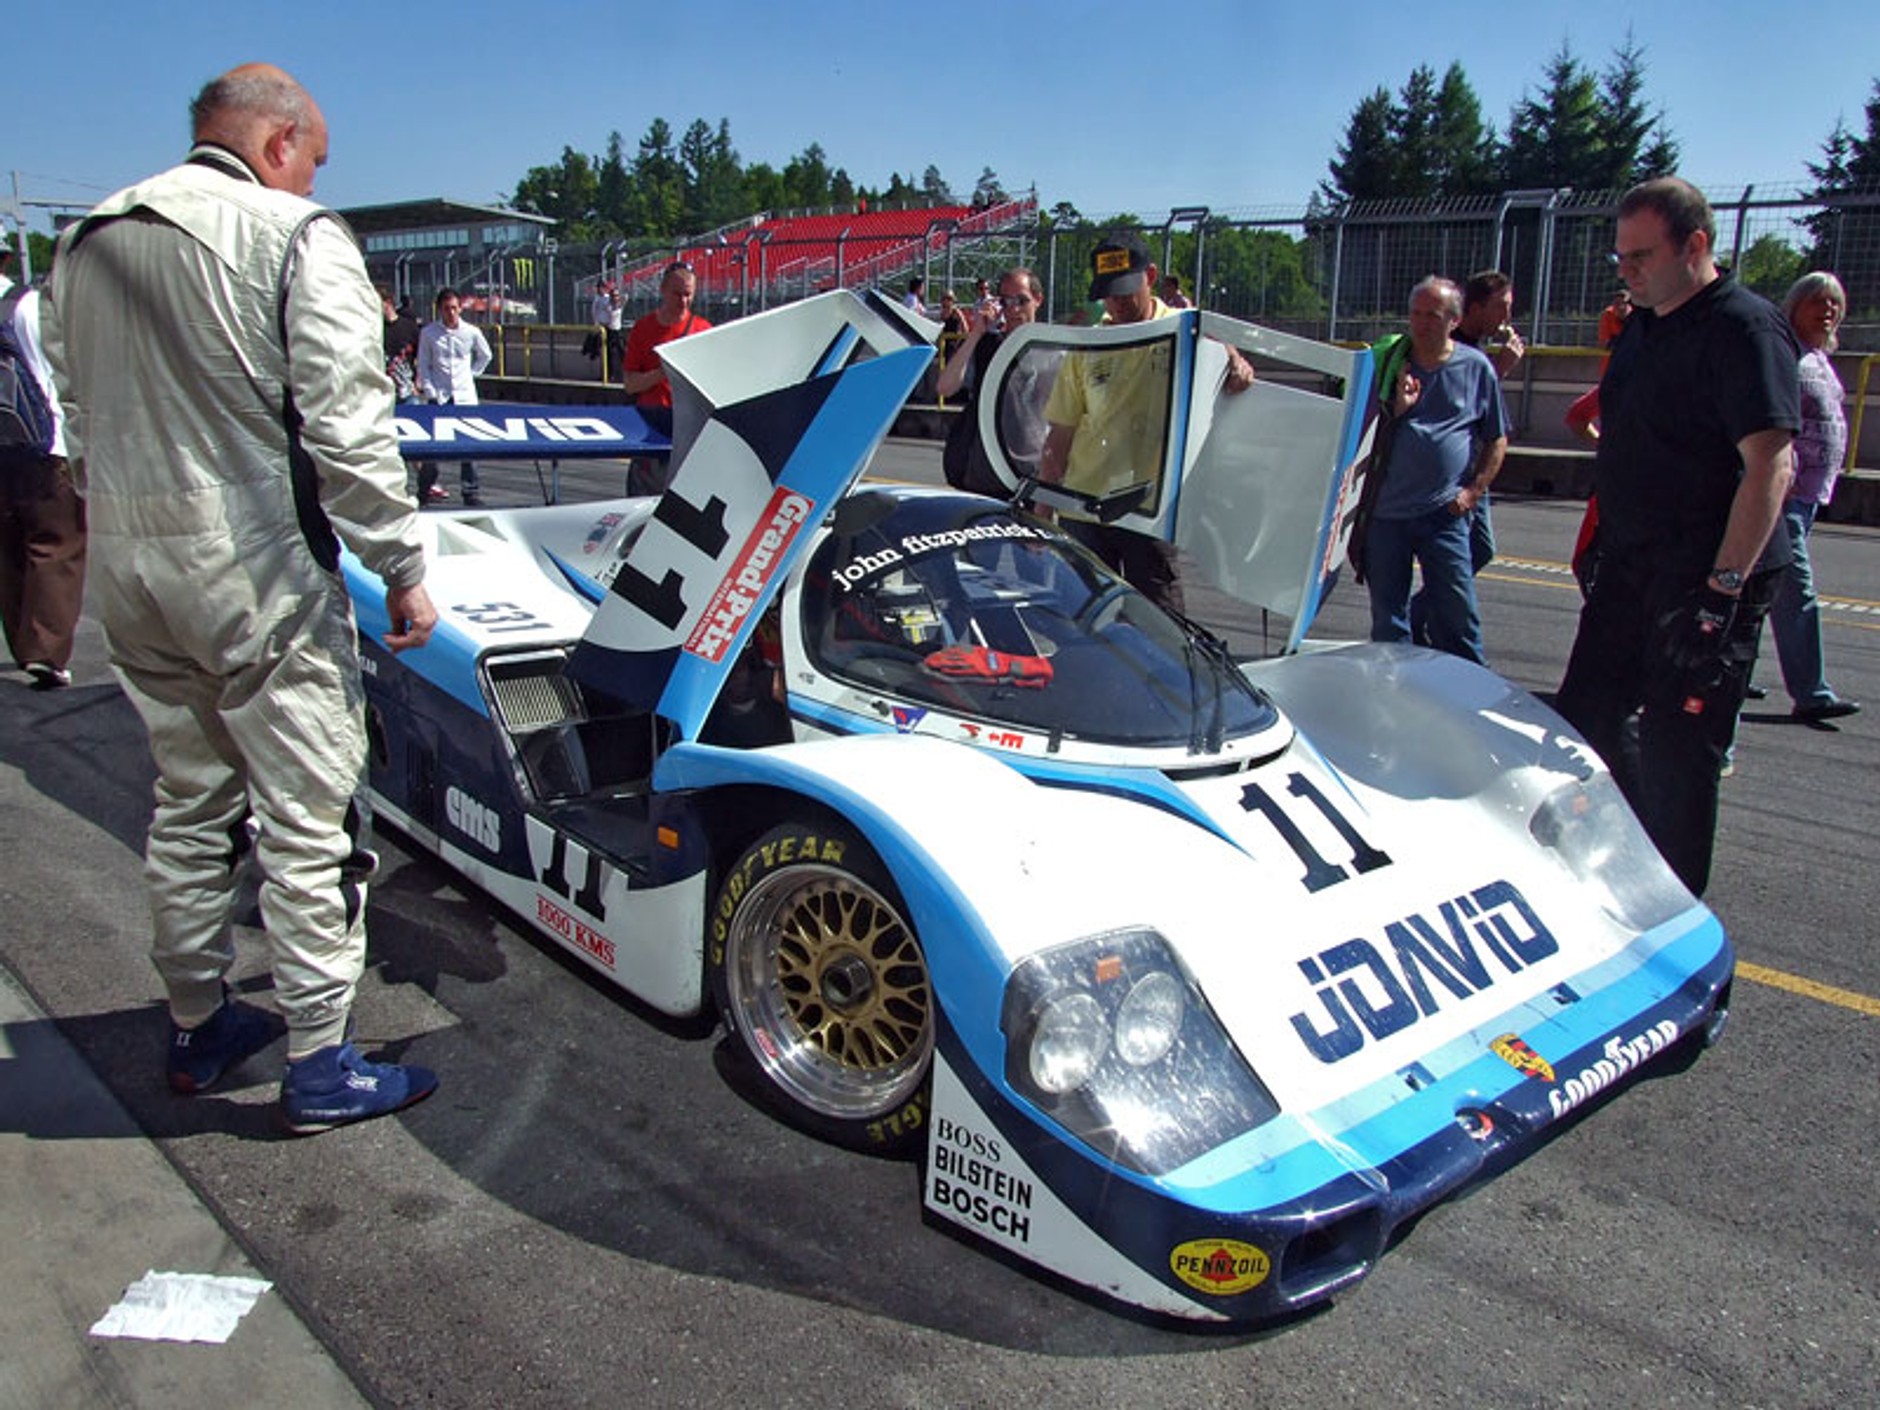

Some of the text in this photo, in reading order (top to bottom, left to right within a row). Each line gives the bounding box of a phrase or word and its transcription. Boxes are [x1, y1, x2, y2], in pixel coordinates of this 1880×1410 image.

[832, 522, 1037, 591] john fitzpatrick
[1238, 771, 1394, 894] 11
[537, 896, 616, 965] 1000 KMS
[1548, 1019, 1678, 1119] GOODYEAR
[937, 1118, 1000, 1162] BOSS
[934, 1177, 1029, 1243] BOSCH
[935, 1144, 1032, 1210] BILSTEIN
[1176, 1255, 1265, 1275] PENNZOIL
